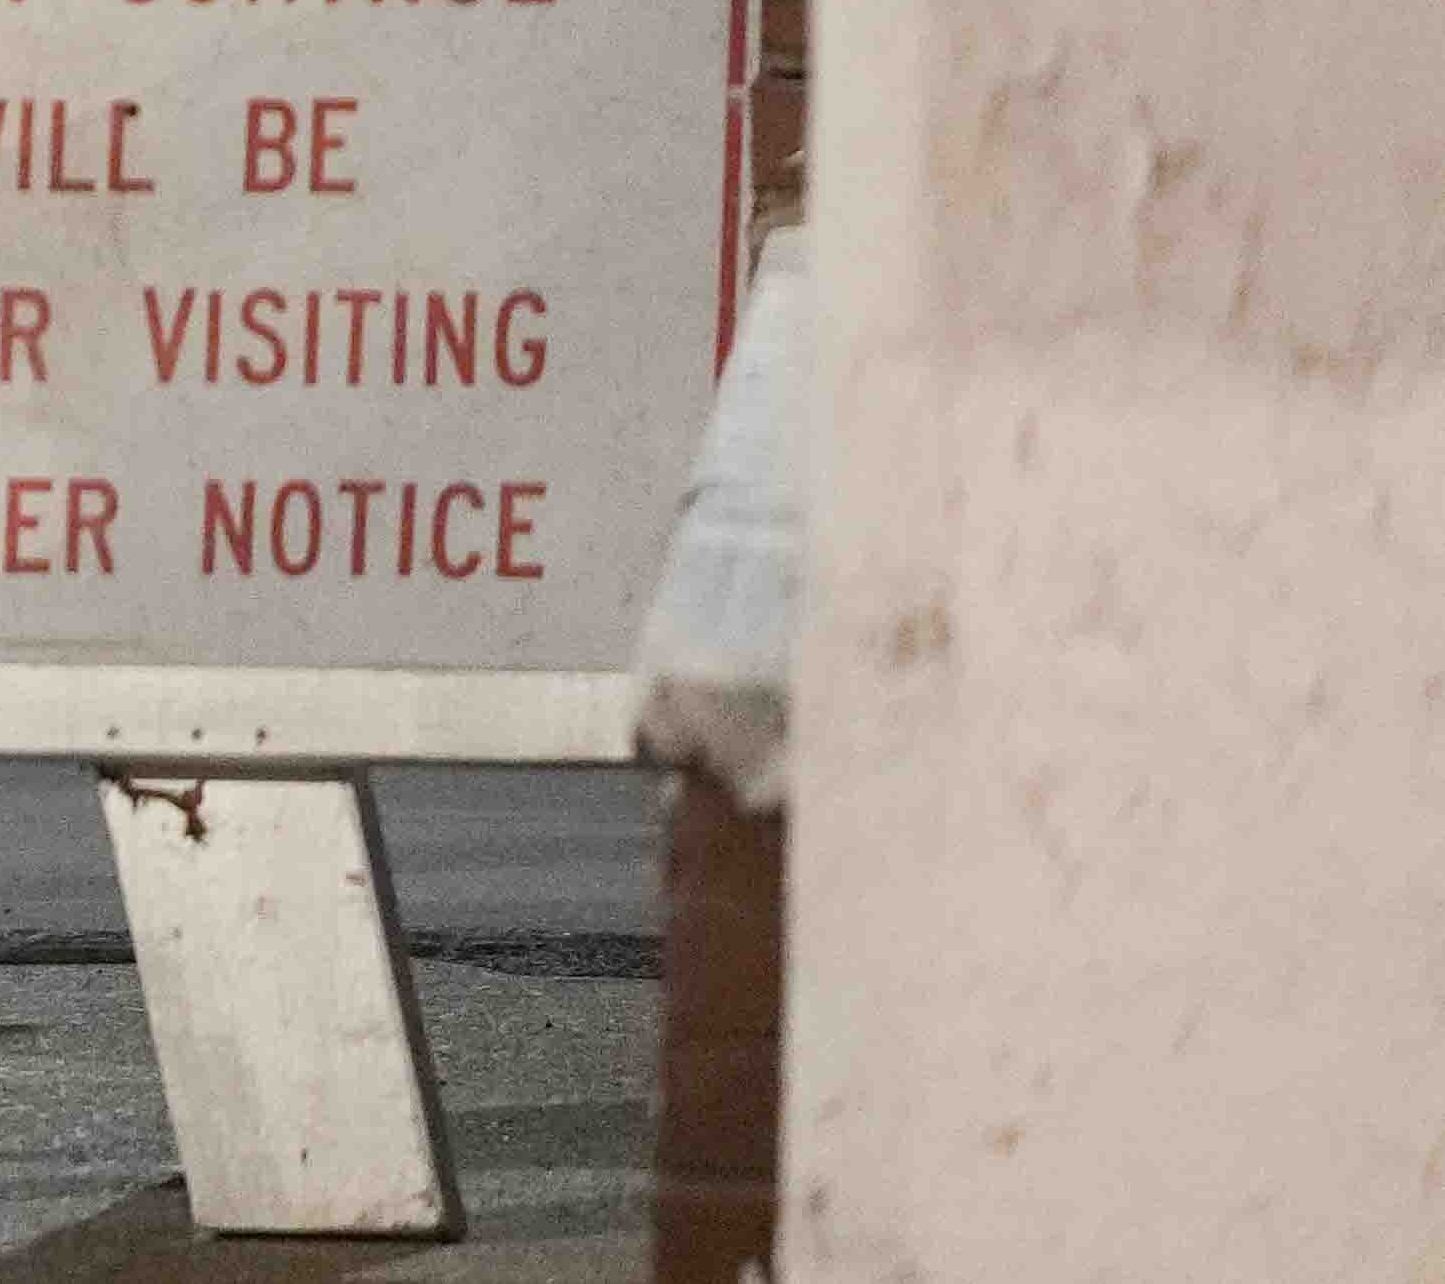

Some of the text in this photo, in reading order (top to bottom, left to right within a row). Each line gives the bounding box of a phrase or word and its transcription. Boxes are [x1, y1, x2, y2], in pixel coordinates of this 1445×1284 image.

[242, 96, 358, 195] BE
[143, 286, 547, 388] VISITING
[201, 477, 547, 579] NOTICE
